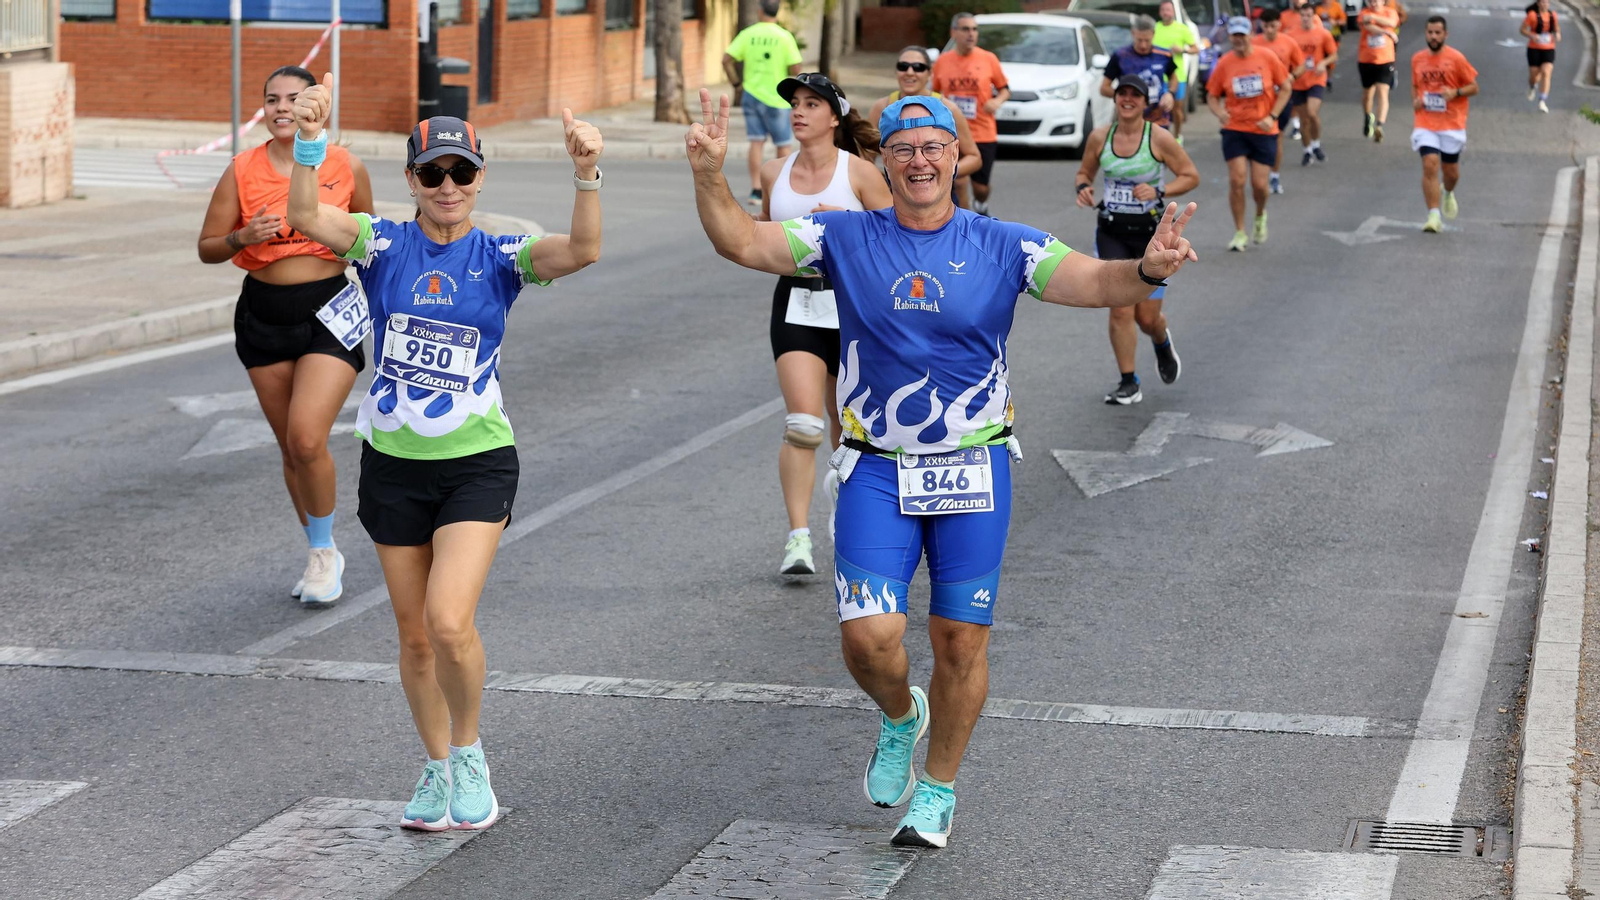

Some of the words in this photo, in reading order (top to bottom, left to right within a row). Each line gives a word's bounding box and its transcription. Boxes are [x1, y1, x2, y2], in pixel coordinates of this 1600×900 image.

[894, 297, 919, 310] Rabita
[406, 339, 453, 369] 950
[922, 468, 970, 492] 846
